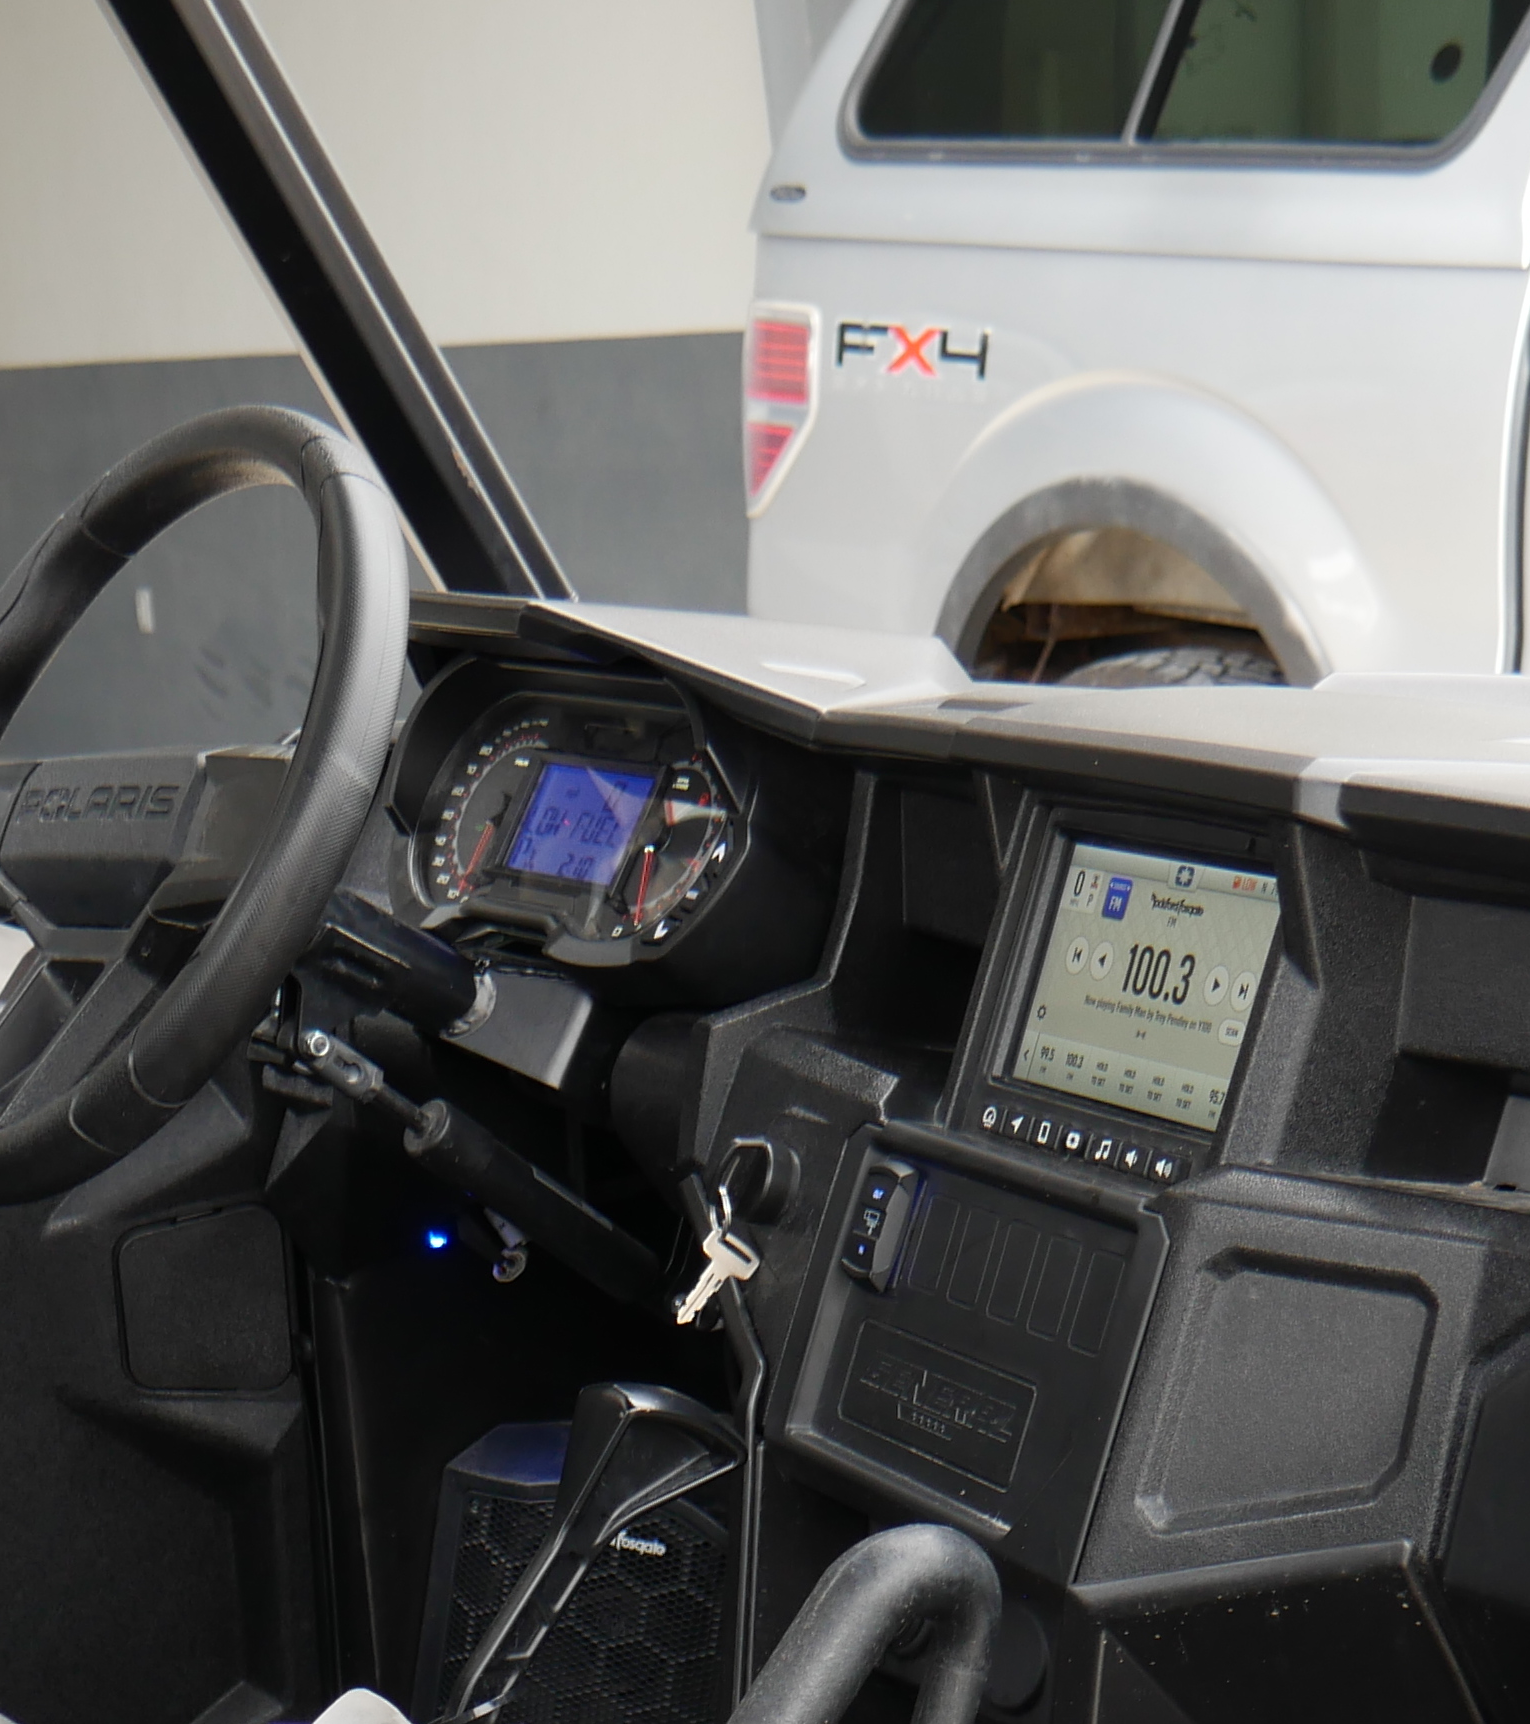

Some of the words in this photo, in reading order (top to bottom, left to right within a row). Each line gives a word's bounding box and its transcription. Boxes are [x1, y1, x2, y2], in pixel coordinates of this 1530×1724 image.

[836, 321, 990, 380] FX4
[16, 785, 180, 823] POLARIS
[1074, 870, 1085, 896] 0
[1108, 895, 1124, 912] FM
[1122, 942, 1196, 1006] 100.3
[1040, 1045, 1056, 1062] 99.5
[1065, 1052, 1085, 1069] 100.3
